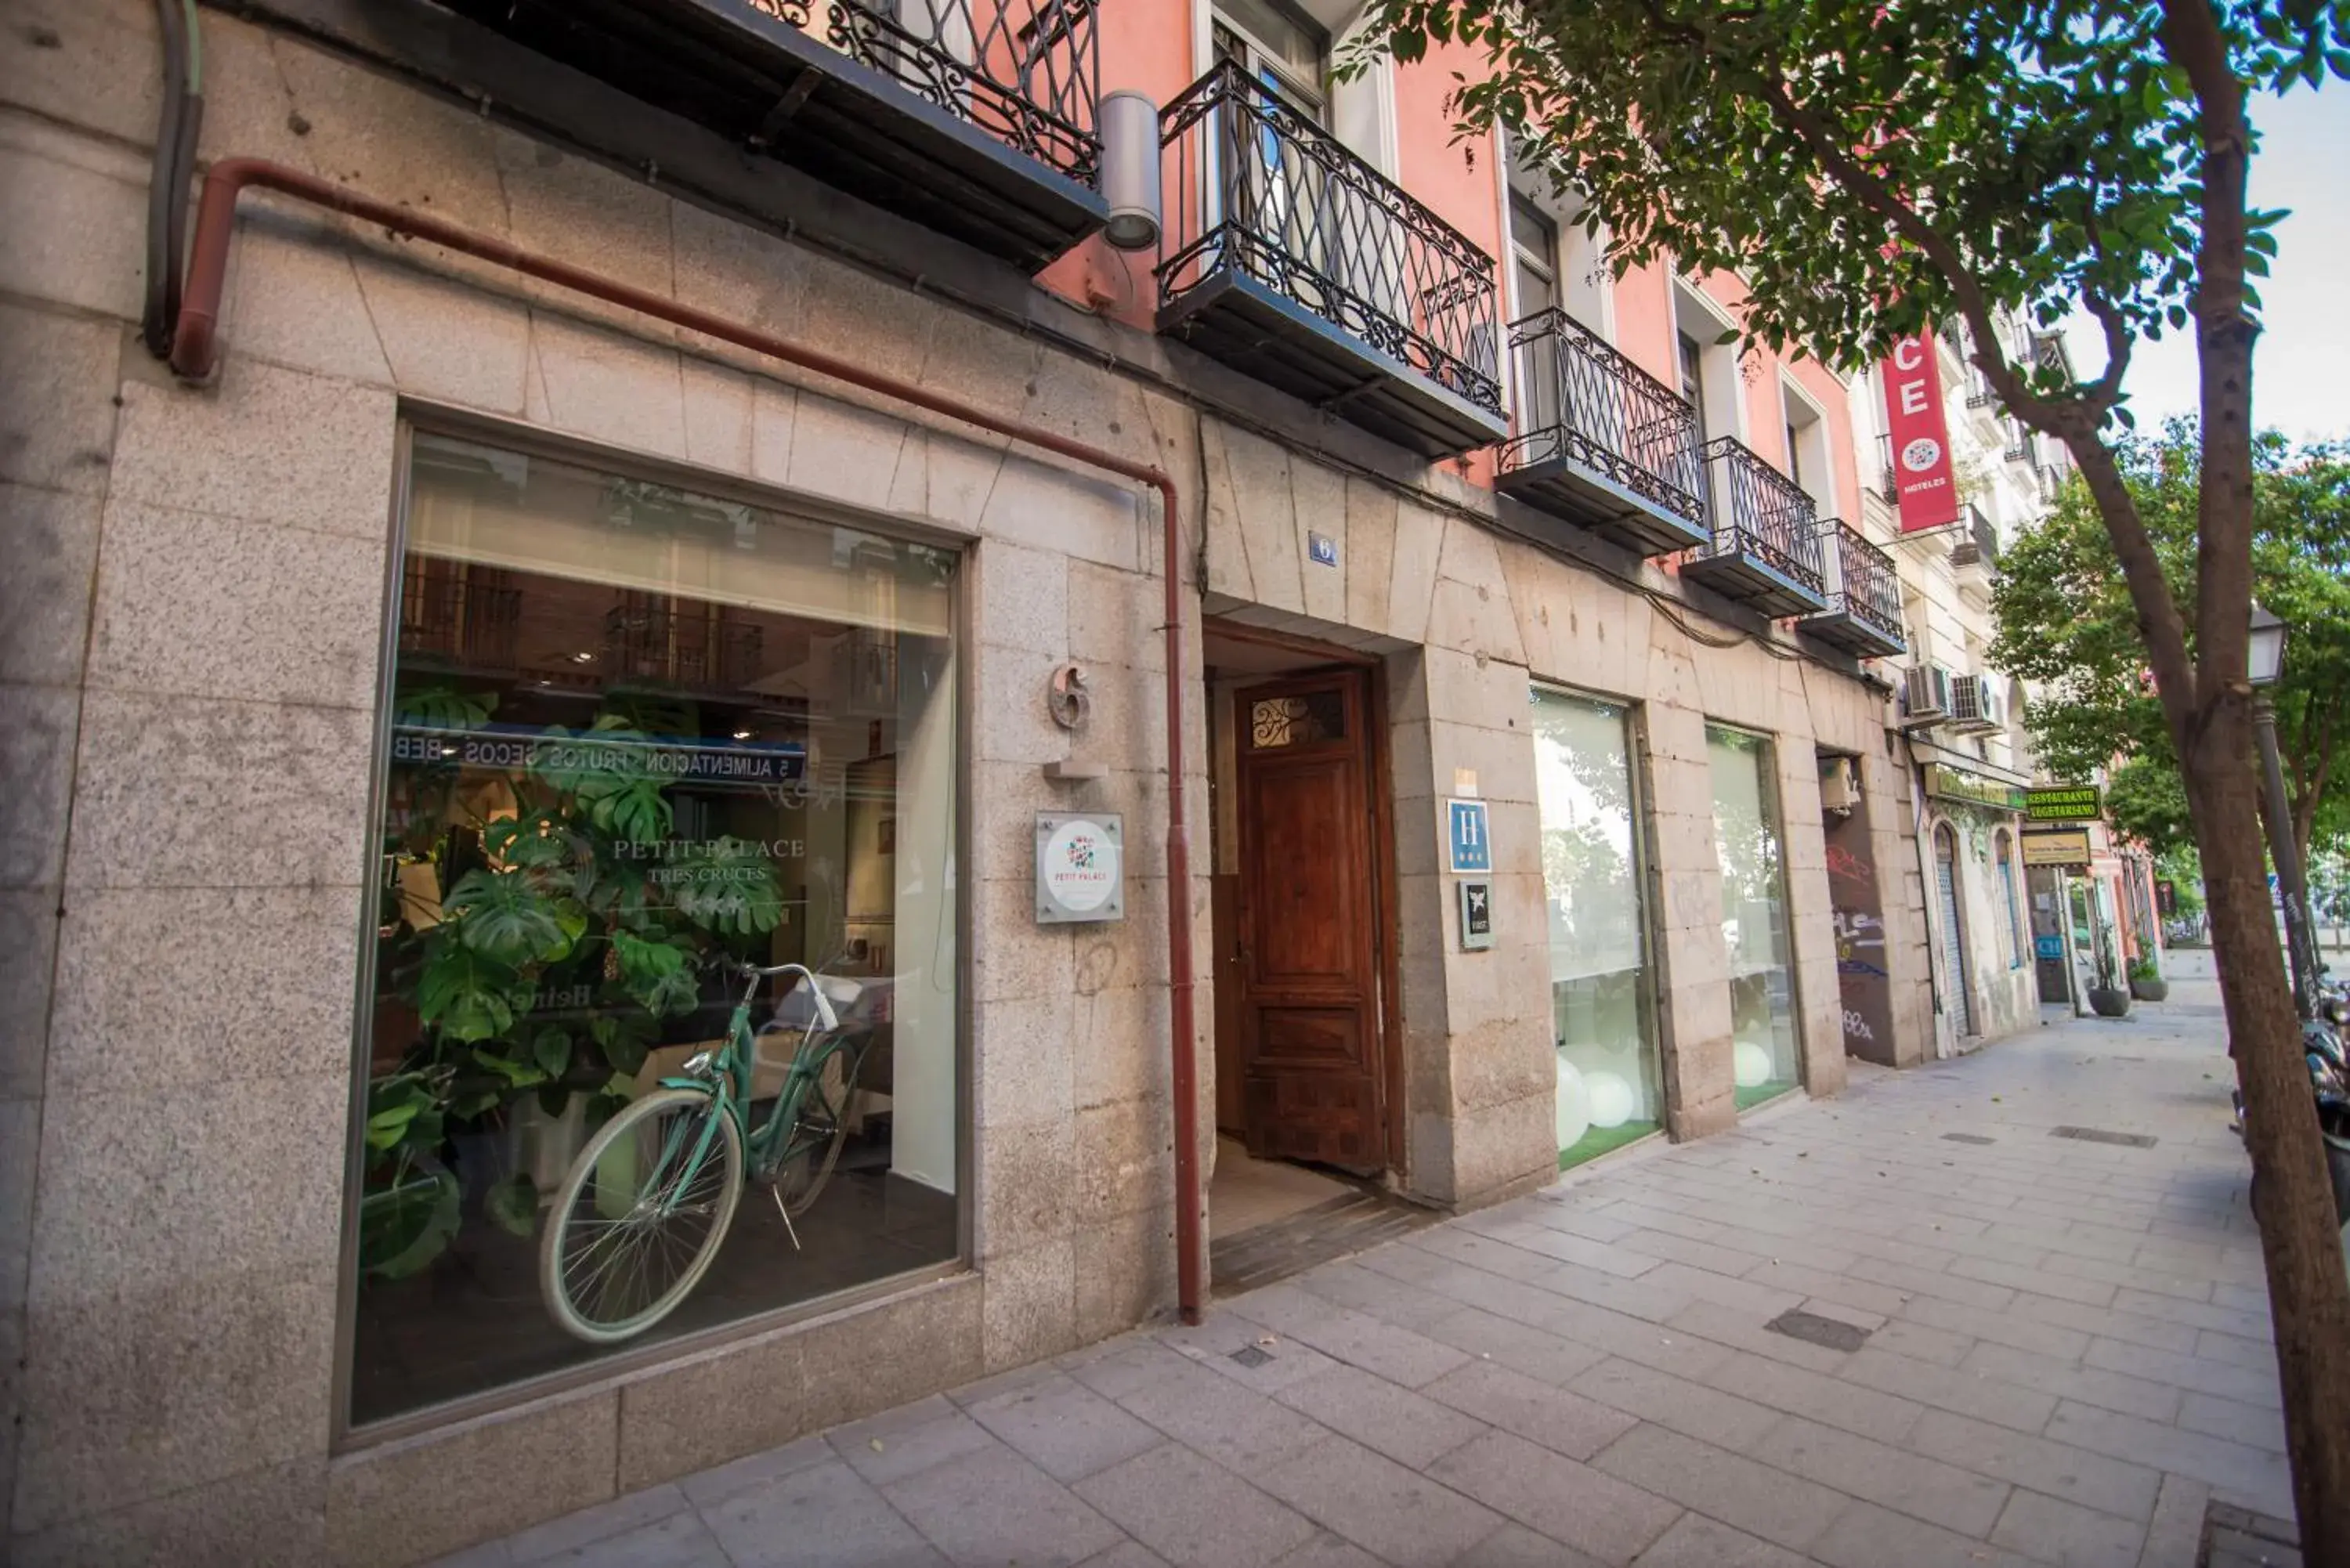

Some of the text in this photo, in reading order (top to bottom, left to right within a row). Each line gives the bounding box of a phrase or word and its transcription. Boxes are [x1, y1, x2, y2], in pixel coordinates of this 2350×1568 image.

[1904, 477, 1946, 495] HOTELES
[1318, 538, 1331, 558] 6
[1048, 663, 1090, 729] 6
[2029, 790, 2095, 804] RESTAURANTE
[2030, 804, 2095, 817] VEGETARIANO
[1460, 810, 1479, 845] H
[613, 840, 695, 859] PETIT
[647, 867, 766, 883] TRES CRUCES
